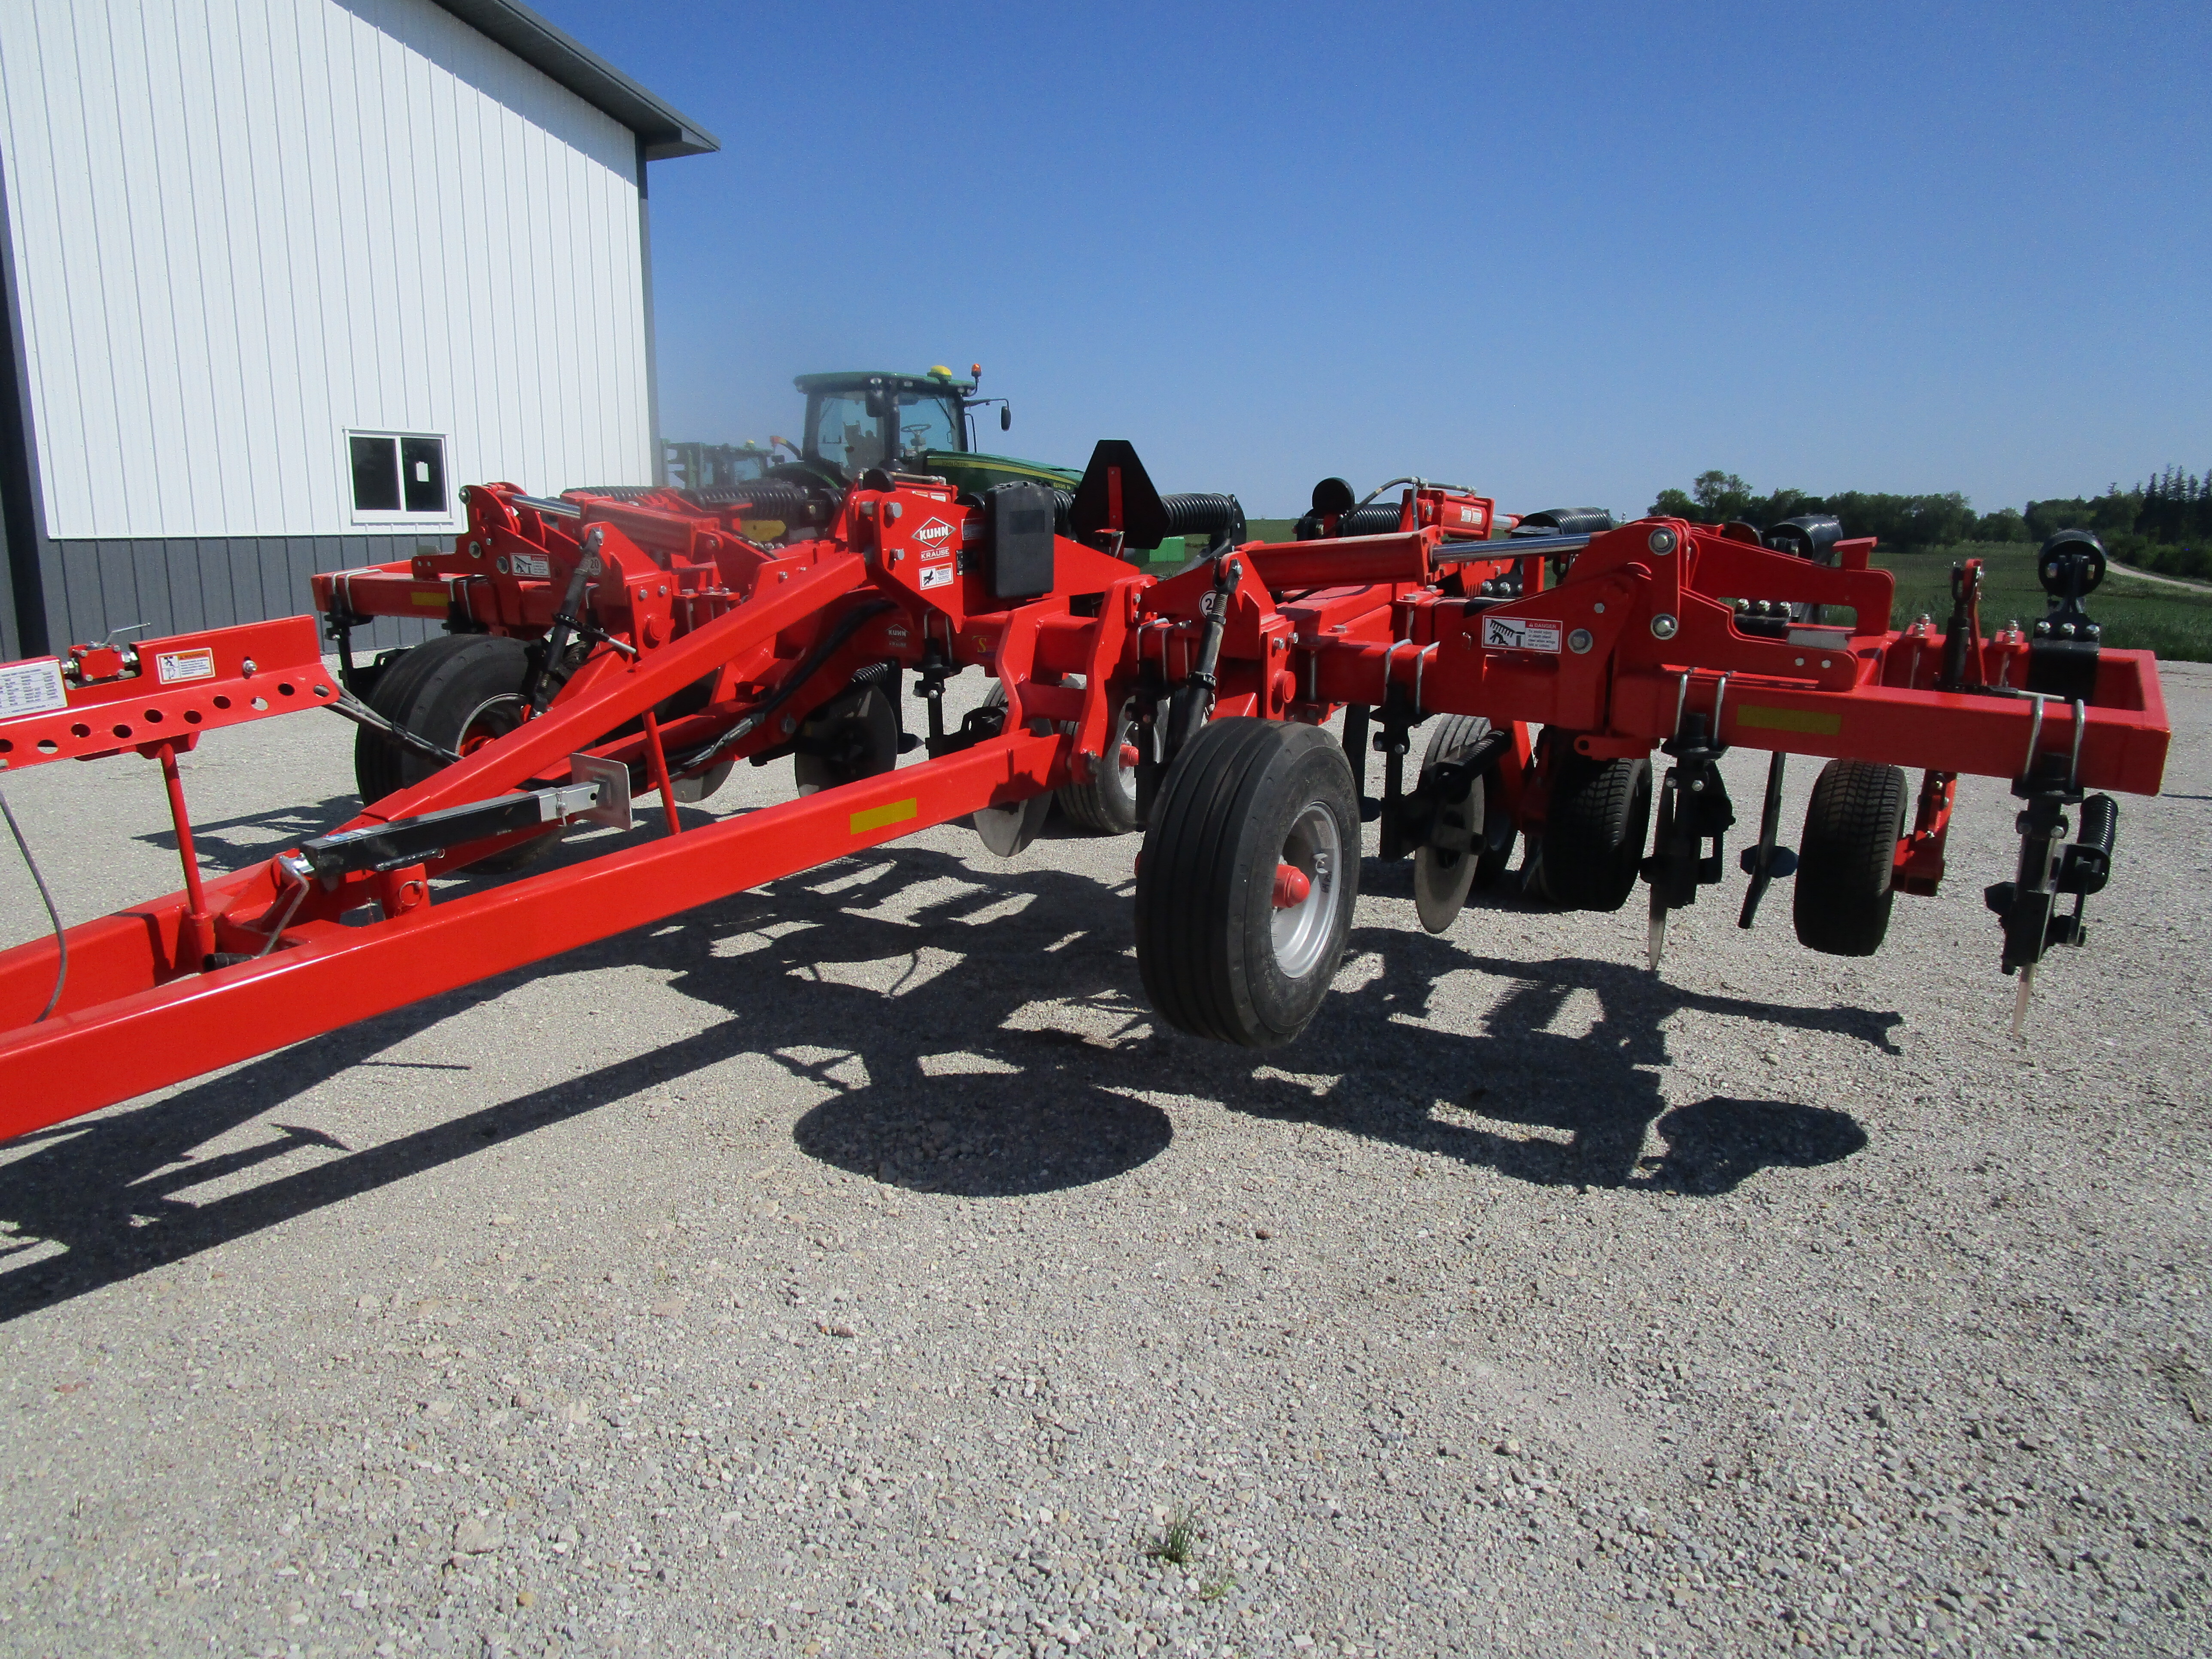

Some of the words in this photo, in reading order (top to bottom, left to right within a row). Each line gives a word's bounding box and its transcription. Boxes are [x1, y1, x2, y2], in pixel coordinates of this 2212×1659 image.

[920, 526, 948, 540] KUHN
[921, 549, 950, 559] KRAUSE
[591, 559, 599, 568] 20
[1205, 598, 1213, 610] 2
